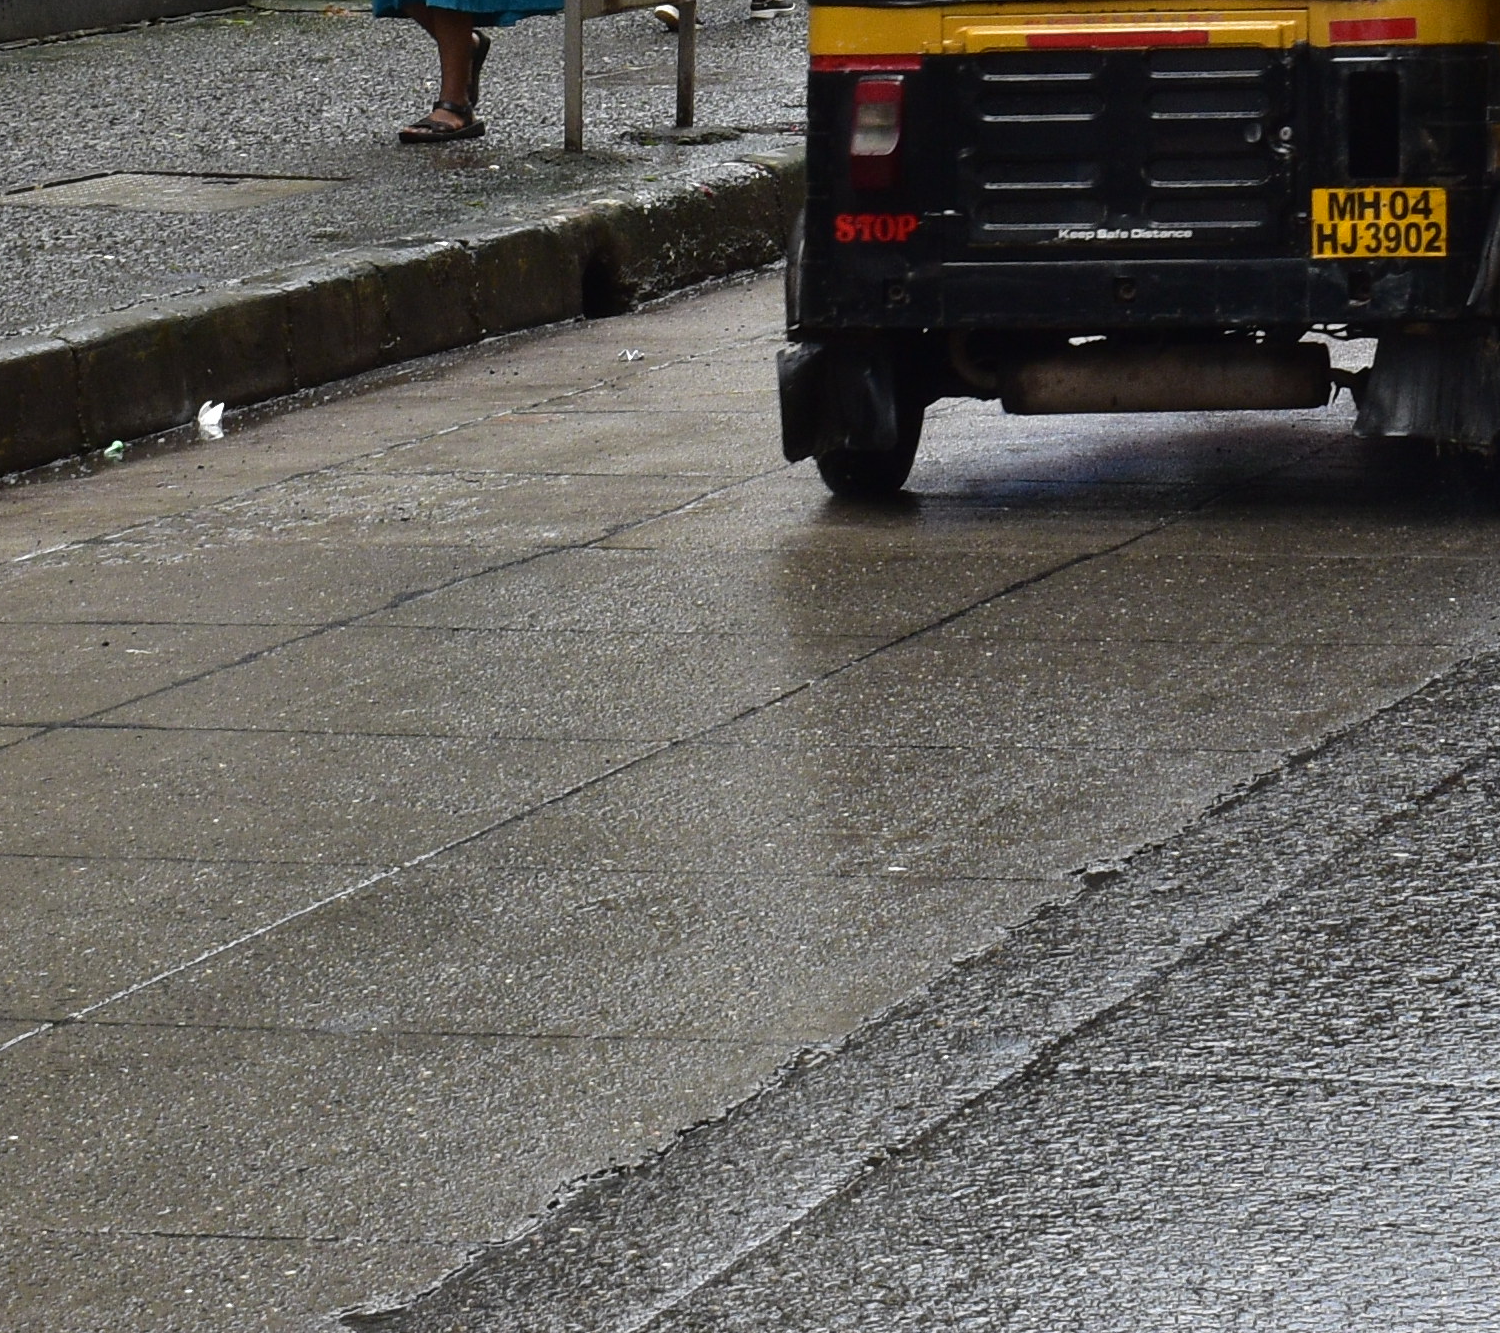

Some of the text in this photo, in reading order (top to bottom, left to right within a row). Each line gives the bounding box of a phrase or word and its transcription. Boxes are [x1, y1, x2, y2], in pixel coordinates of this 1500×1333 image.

[834, 213, 919, 243] STOP
[1058, 228, 1193, 241] Keep Safe Distance
